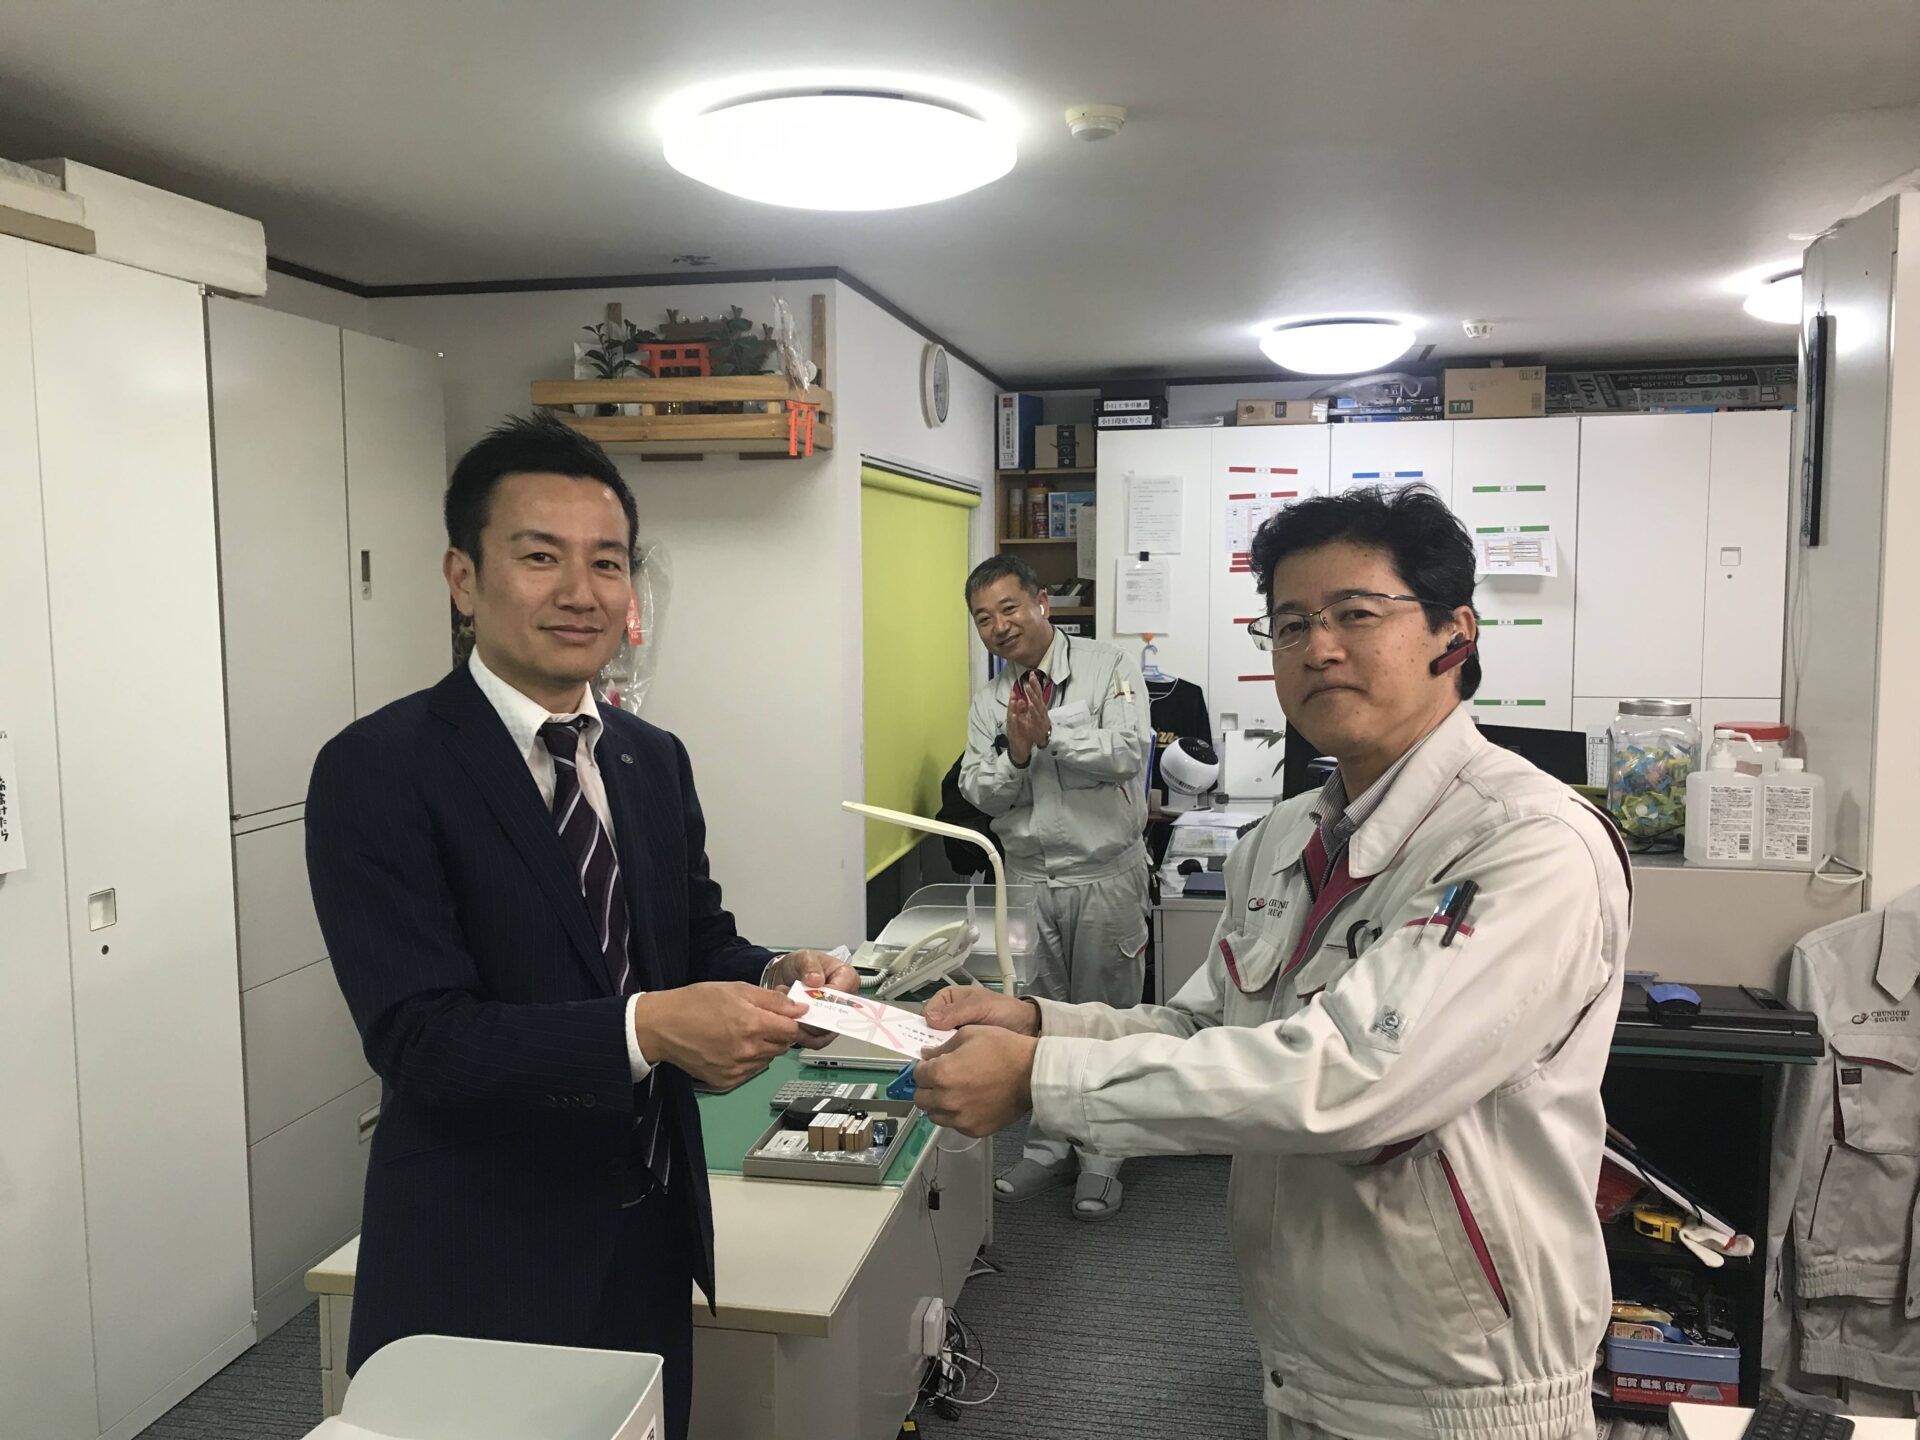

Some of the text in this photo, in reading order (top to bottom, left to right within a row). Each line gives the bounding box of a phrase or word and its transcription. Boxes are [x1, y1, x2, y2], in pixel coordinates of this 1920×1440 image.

[1452, 402, 1472, 413] TM
[1616, 1376, 1638, 1388] 鑑賞
[1640, 1379, 1661, 1390] 編集
[1664, 1381, 1686, 1393] 保存
